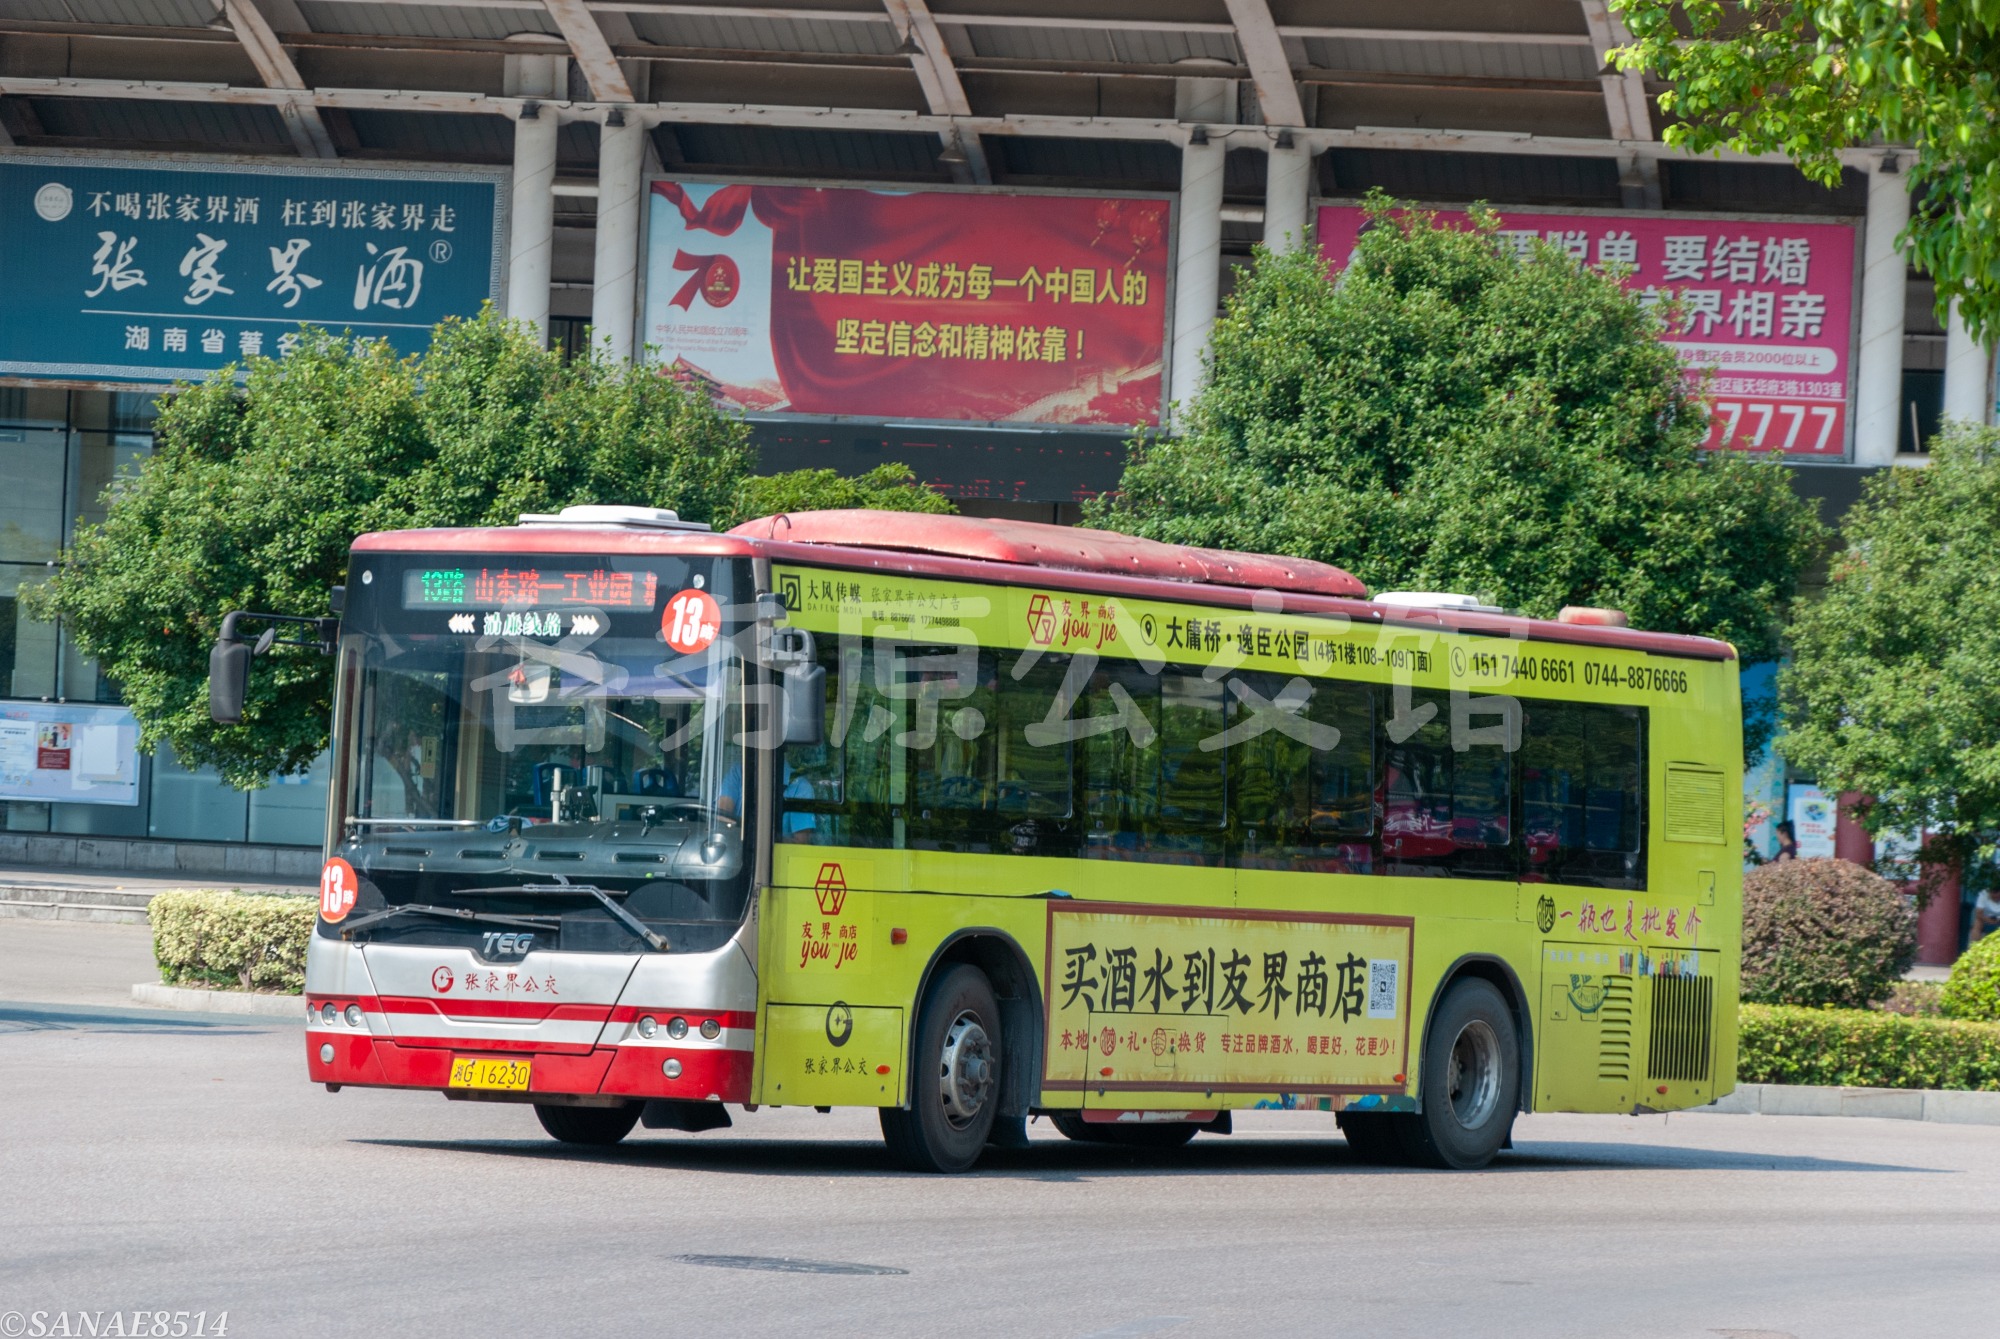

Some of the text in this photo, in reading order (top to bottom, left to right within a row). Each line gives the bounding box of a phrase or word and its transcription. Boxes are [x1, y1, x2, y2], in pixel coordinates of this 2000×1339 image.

[86, 190, 457, 232] 不喝张家界酒 枉到张家界走
[84, 231, 423, 310] 张家界酒
[786, 256, 1148, 306] 让爱国主义成为每一个中国人的
[1661, 235, 1811, 285] 要结婚
[834, 318, 1085, 363] 坚定信念和精神依靠！
[807, 578, 960, 611] 大风传媒 张家界市公交广告
[1062, 618, 1091, 647] you
[1473, 651, 1688, 694] 151 7440 6661 0744-8876666
[482, 932, 534, 954] TEG
[799, 940, 831, 969] you
[465, 971, 559, 995] 张家界公交
[1060, 942, 1368, 1024] 买酒水到友界商店
[804, 1056, 868, 1076] 张家界公交
